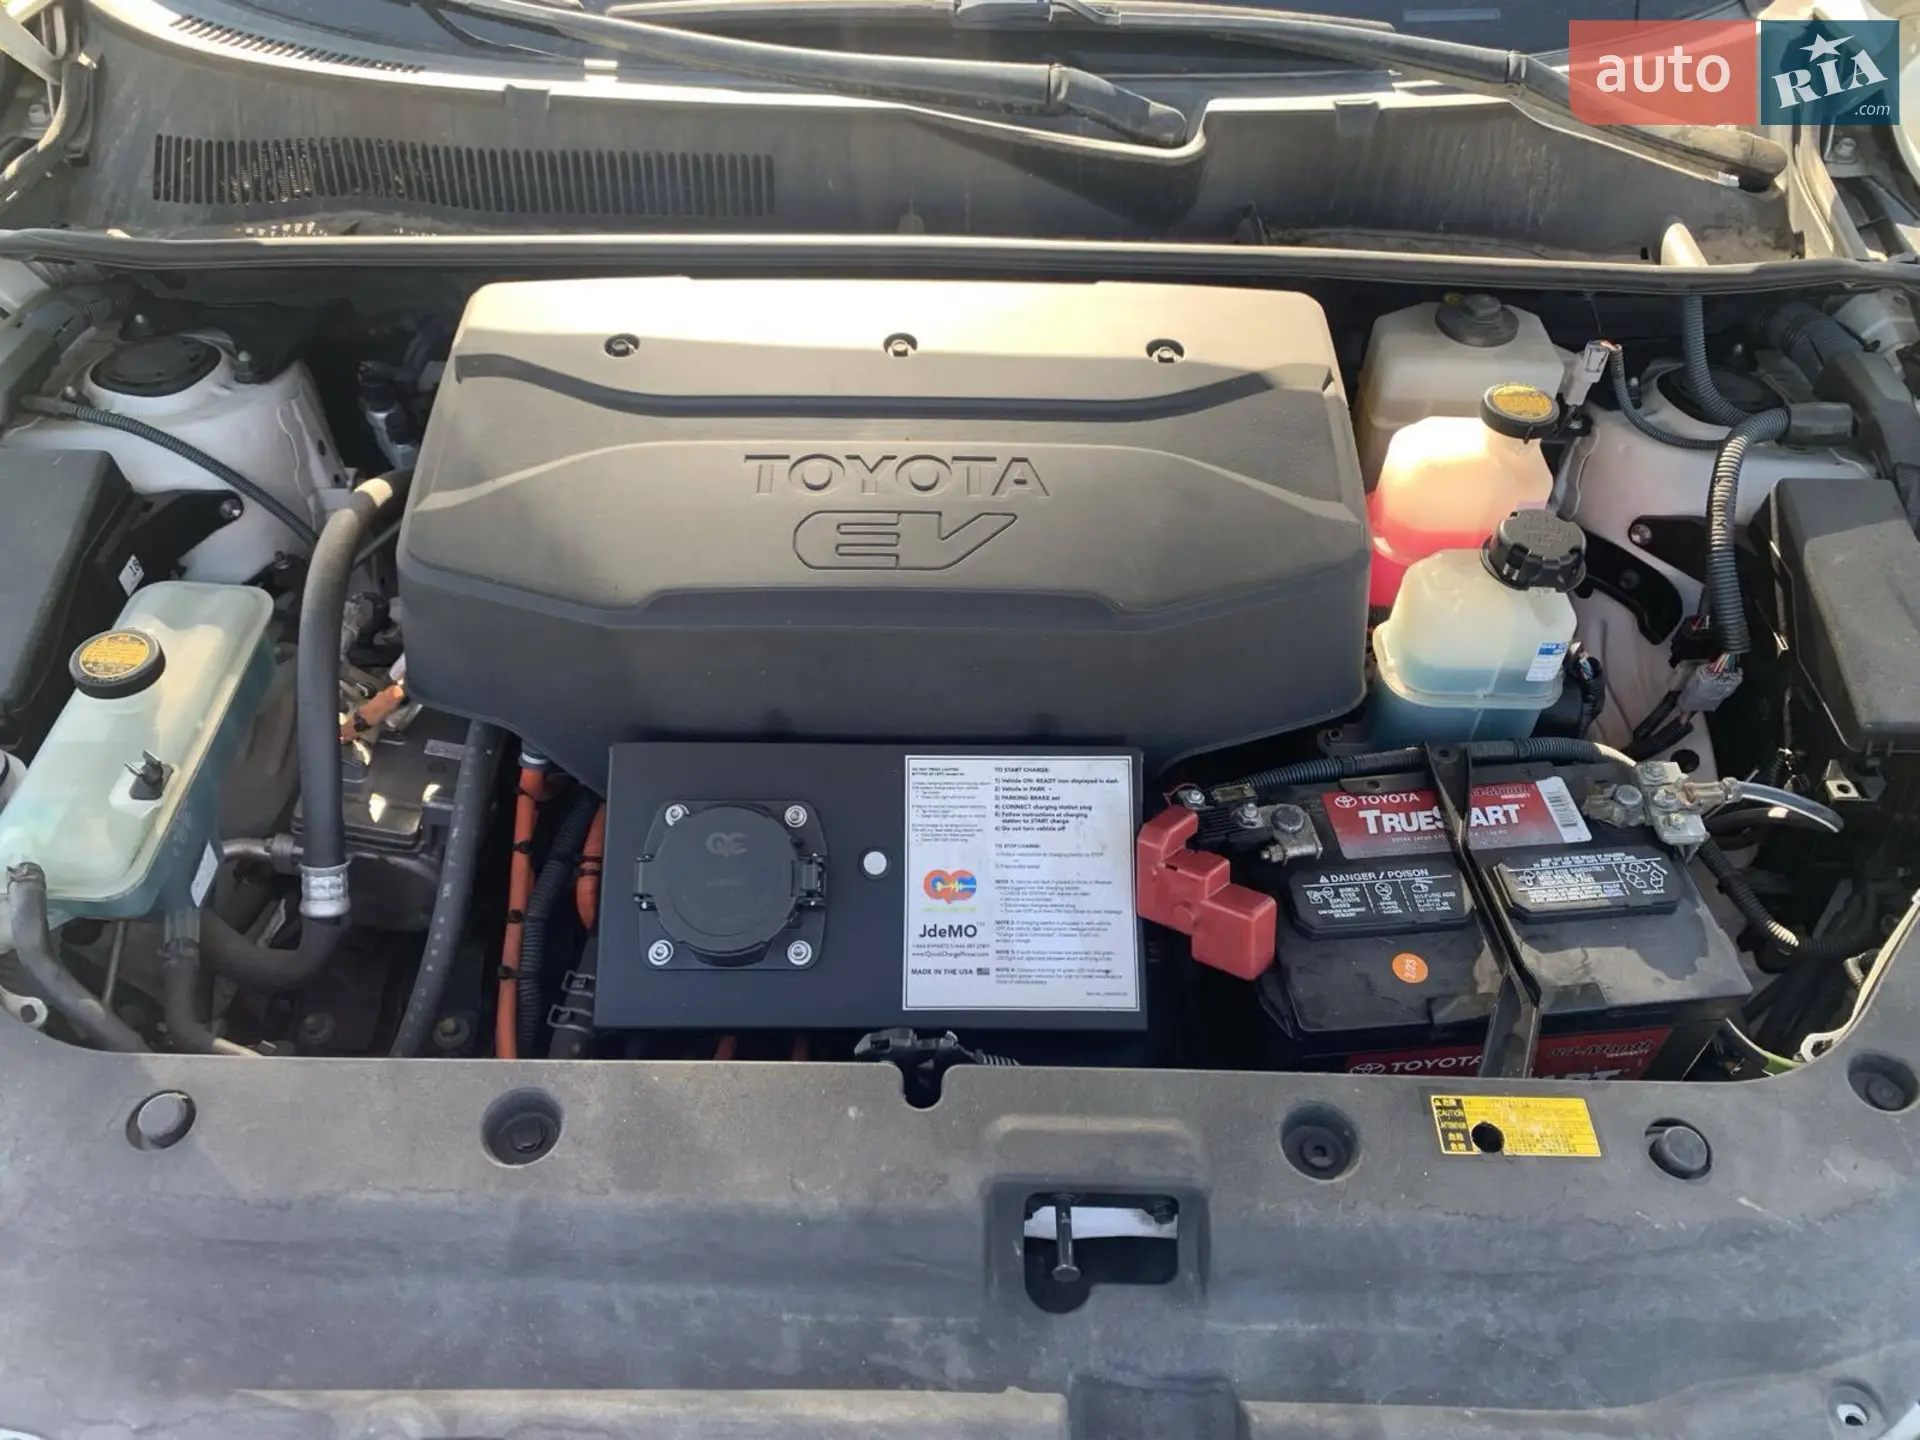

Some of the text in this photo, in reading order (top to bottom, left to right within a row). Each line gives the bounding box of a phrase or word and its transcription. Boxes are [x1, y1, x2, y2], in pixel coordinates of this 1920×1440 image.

[744, 454, 1049, 497] TOYOTA
[793, 510, 1017, 570] EV
[1071, 777, 1097, 786] displayed
[1358, 793, 1420, 806] TOYOTA
[1033, 803, 1057, 811] charging
[1080, 803, 1092, 811] plug
[1063, 811, 1088, 820] charging
[1330, 870, 1377, 883] DANGER
[1387, 868, 1429, 879] POISON
[919, 924, 977, 938] JdeMO
[1392, 1055, 1484, 1072] TOYOTA
[1436, 1108, 1464, 1117] CAUTION
